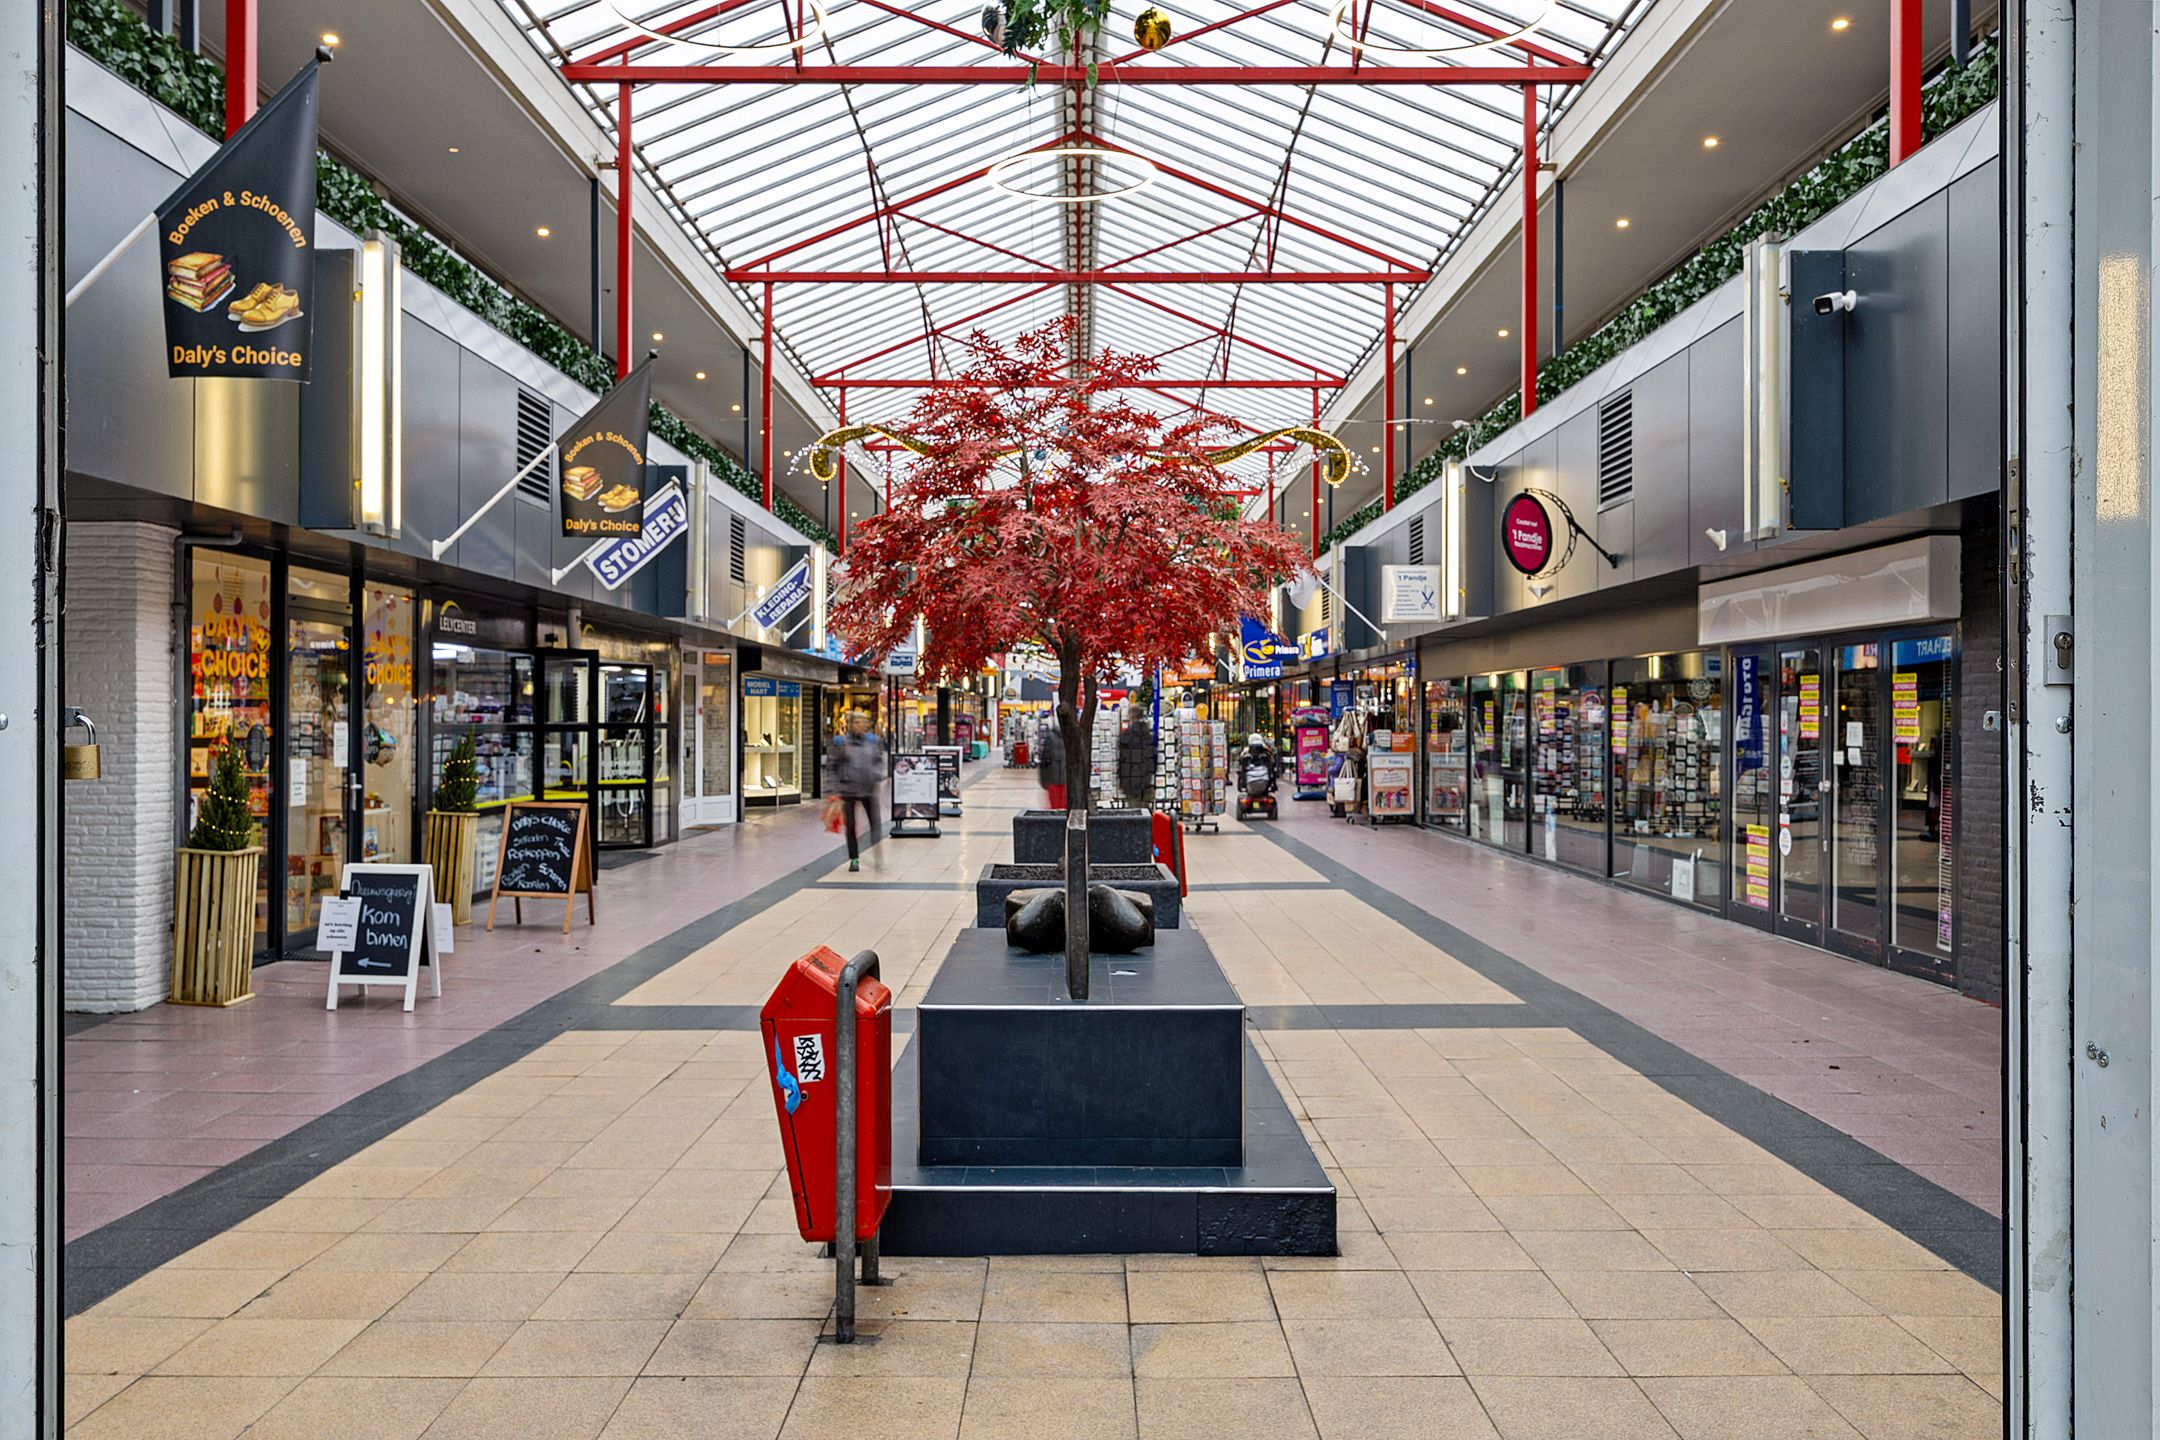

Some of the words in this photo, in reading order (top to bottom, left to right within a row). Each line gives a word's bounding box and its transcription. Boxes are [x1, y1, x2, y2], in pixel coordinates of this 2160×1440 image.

[169, 199, 219, 245] Boeken
[223, 191, 235, 206] &
[240, 190, 307, 248] Schoenen
[173, 345, 226, 368] Daly's
[231, 345, 302, 366] Choice
[564, 435, 594, 462] Boeken
[596, 432, 603, 441] &
[606, 431, 643, 465] Schoenen
[565, 519, 597, 532] Daly's
[600, 519, 640, 532] Choice
[1518, 530, 1543, 546] Pandje
[439, 616, 477, 635] LELYCENTER
[1275, 645, 1299, 655] Primera
[201, 649, 268, 678] CHOICE
[367, 662, 413, 685] CHOICE
[1244, 665, 1281, 678] Primera
[541, 816, 572, 834] Choice
[361, 904, 400, 927] Kom
[366, 928, 408, 949] binnen
